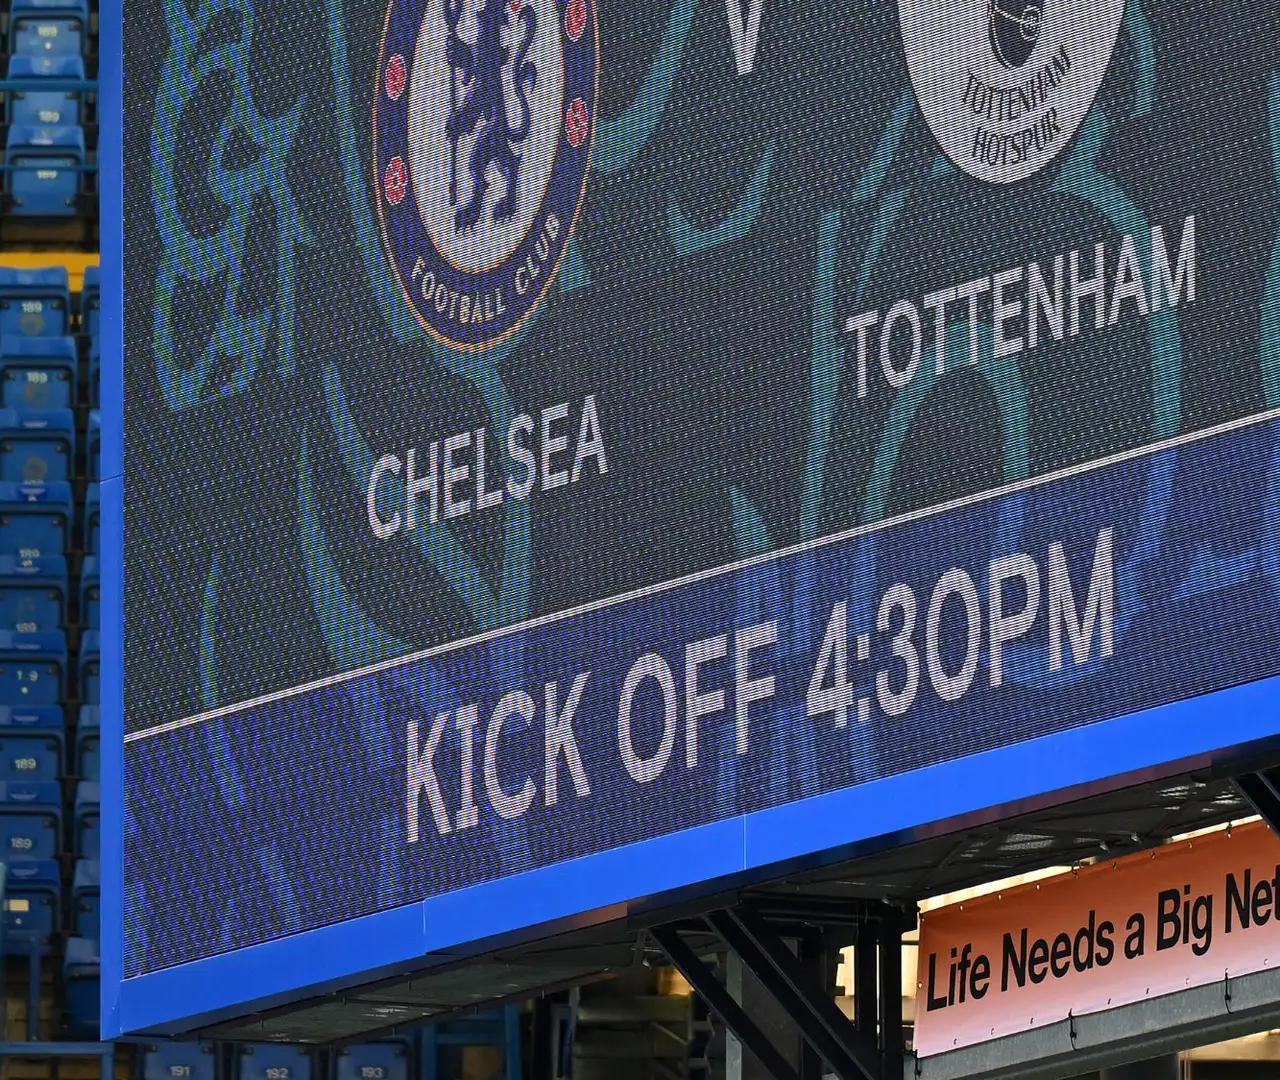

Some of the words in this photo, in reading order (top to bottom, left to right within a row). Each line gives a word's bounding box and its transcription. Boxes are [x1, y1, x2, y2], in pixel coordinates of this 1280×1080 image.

[962, 43, 1070, 119] TOTTENHAM
[972, 107, 1061, 165] HOTSPUR
[412, 256, 506, 323] FOOTBALL
[515, 213, 559, 294] CLUB
[846, 215, 1196, 398] TOTTENHAM
[366, 395, 609, 539] CHELSEA
[404, 670, 590, 843] KICK
[617, 620, 778, 784] OFF
[807, 527, 1115, 729] 4:30PM
[15, 758, 36, 770] 189
[11, 838, 32, 849] 189
[926, 943, 990, 1012] Life
[1000, 910, 1114, 991] Needs
[1124, 913, 1145, 959] a
[1157, 884, 1214, 956] Big
[170, 1066, 189, 1076] 191
[265, 1068, 287, 1078] 192
[361, 1067, 382, 1077] 193
